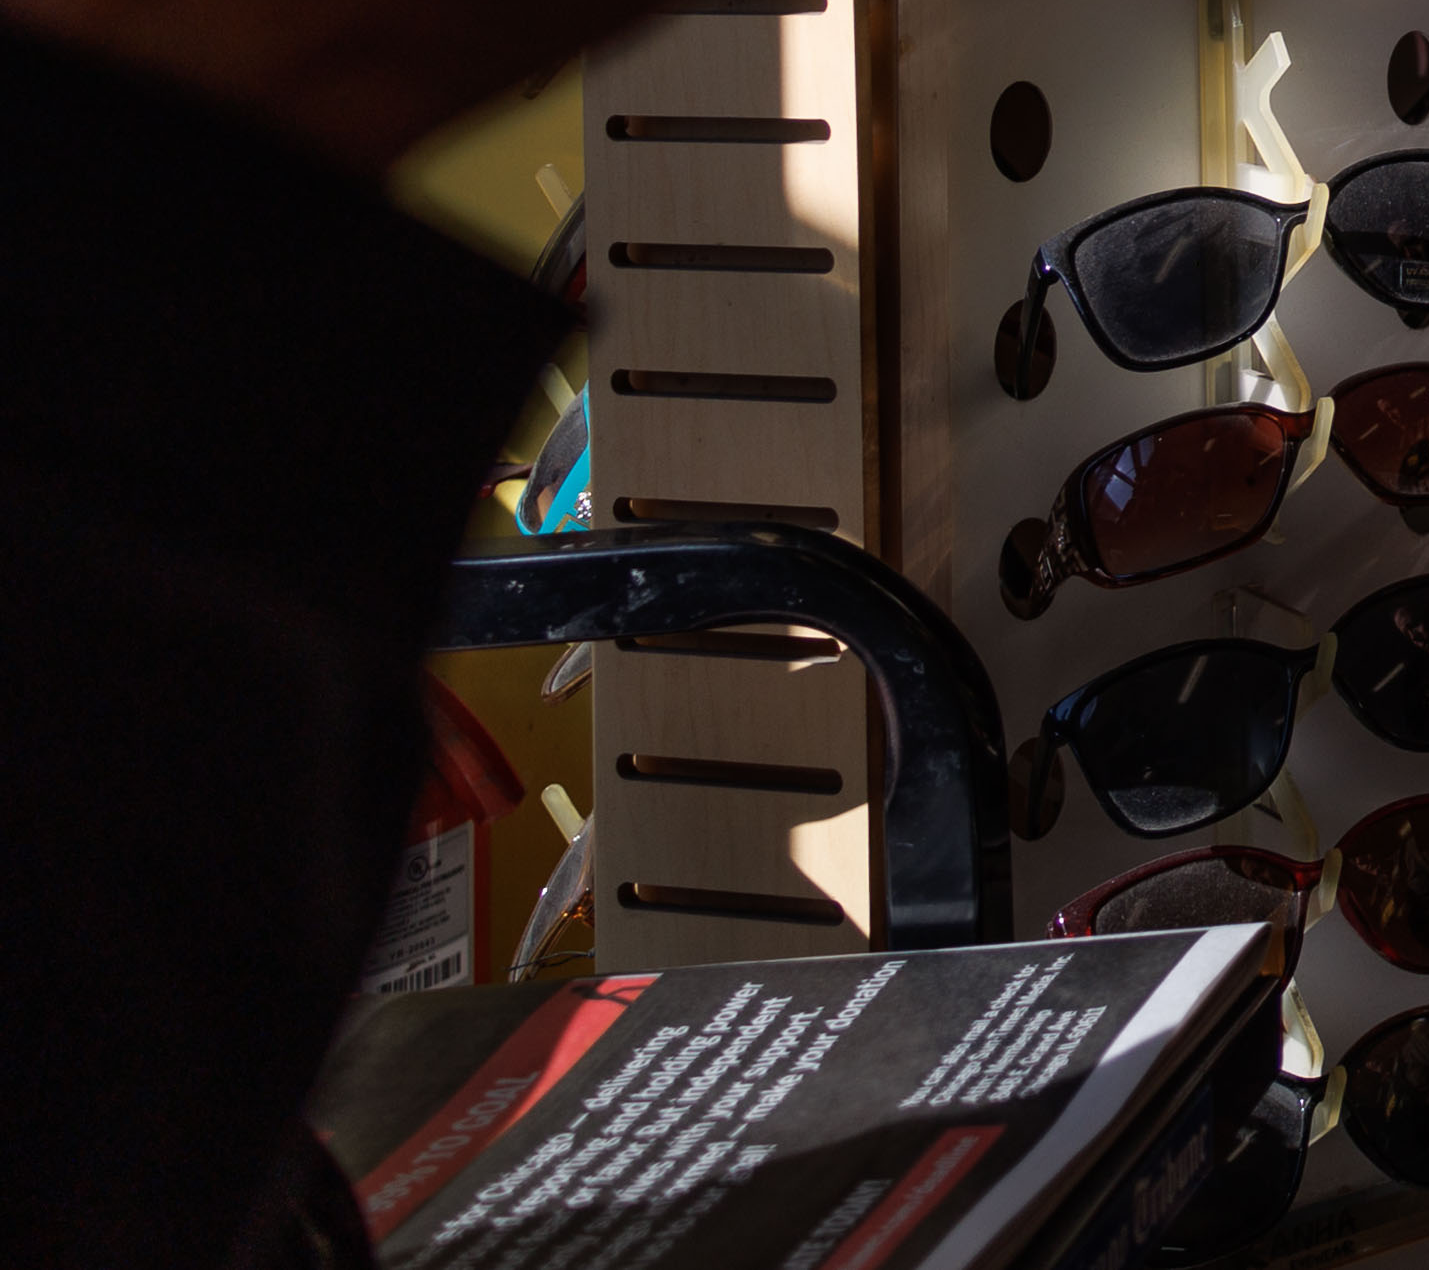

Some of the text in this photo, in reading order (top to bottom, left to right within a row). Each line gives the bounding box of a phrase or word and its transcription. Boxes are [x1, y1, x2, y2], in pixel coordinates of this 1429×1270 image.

[510, 980, 765, 1217] reporting and holding power
[581, 1137, 654, 1187] favor.
[634, 1105, 691, 1144] But
[677, 995, 793, 1107] independent
[664, 1122, 717, 1163] with
[703, 1081, 754, 1121] your
[742, 1005, 824, 1080] support.
[743, 1073, 804, 1123] make
[794, 1034, 841, 1073] your
[824, 959, 909, 1032] donation
[898, 1086, 934, 1109] You
[922, 1065, 951, 1086] can
[941, 1042, 972, 1065] also
[961, 1019, 994, 1042] mail
[989, 978, 1028, 1011] check
[1047, 1010, 1078, 1033] Ave
[412, 1134, 471, 1165] TO
[451, 1070, 542, 1132] GOAL
[476, 1131, 575, 1202] Chicago
[583, 1025, 690, 1111] delivering
[804, 1176, 898, 1240] TODAY!
